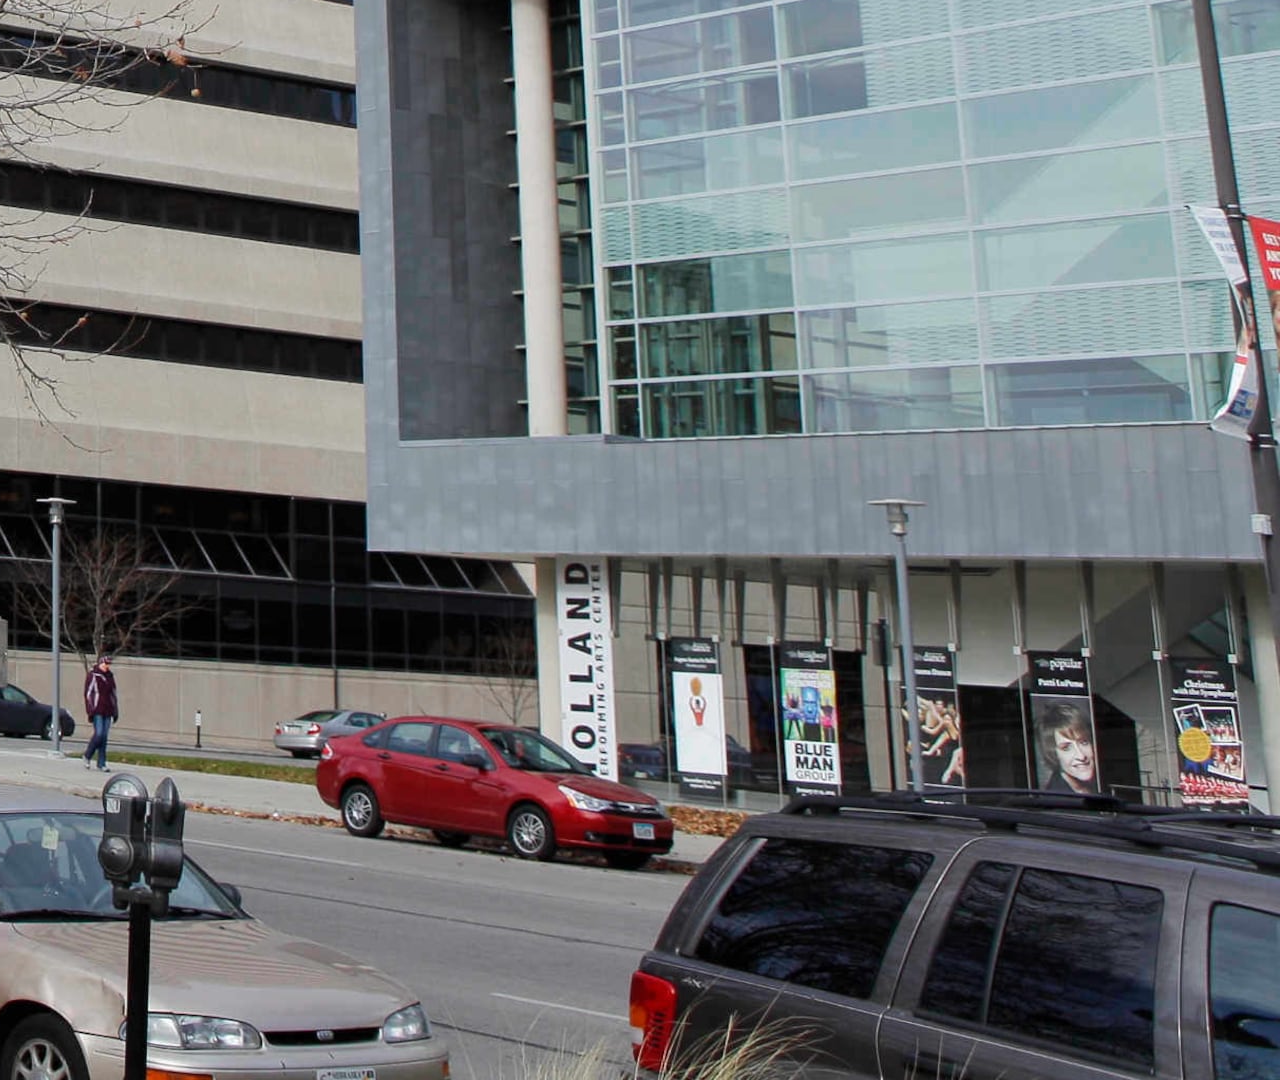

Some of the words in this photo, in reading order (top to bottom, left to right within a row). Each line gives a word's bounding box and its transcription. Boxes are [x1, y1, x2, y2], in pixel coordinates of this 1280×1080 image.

[591, 564, 603, 623] CENTER
[594, 633, 604, 672] ARTS
[1049, 660, 1083, 671] popular
[1184, 680, 1225, 690] Christmas
[596, 683, 609, 776] ERFORMING
[795, 743, 832, 757] BLUE
[796, 756, 833, 771] MAN
[795, 770, 835, 781] GROUP
